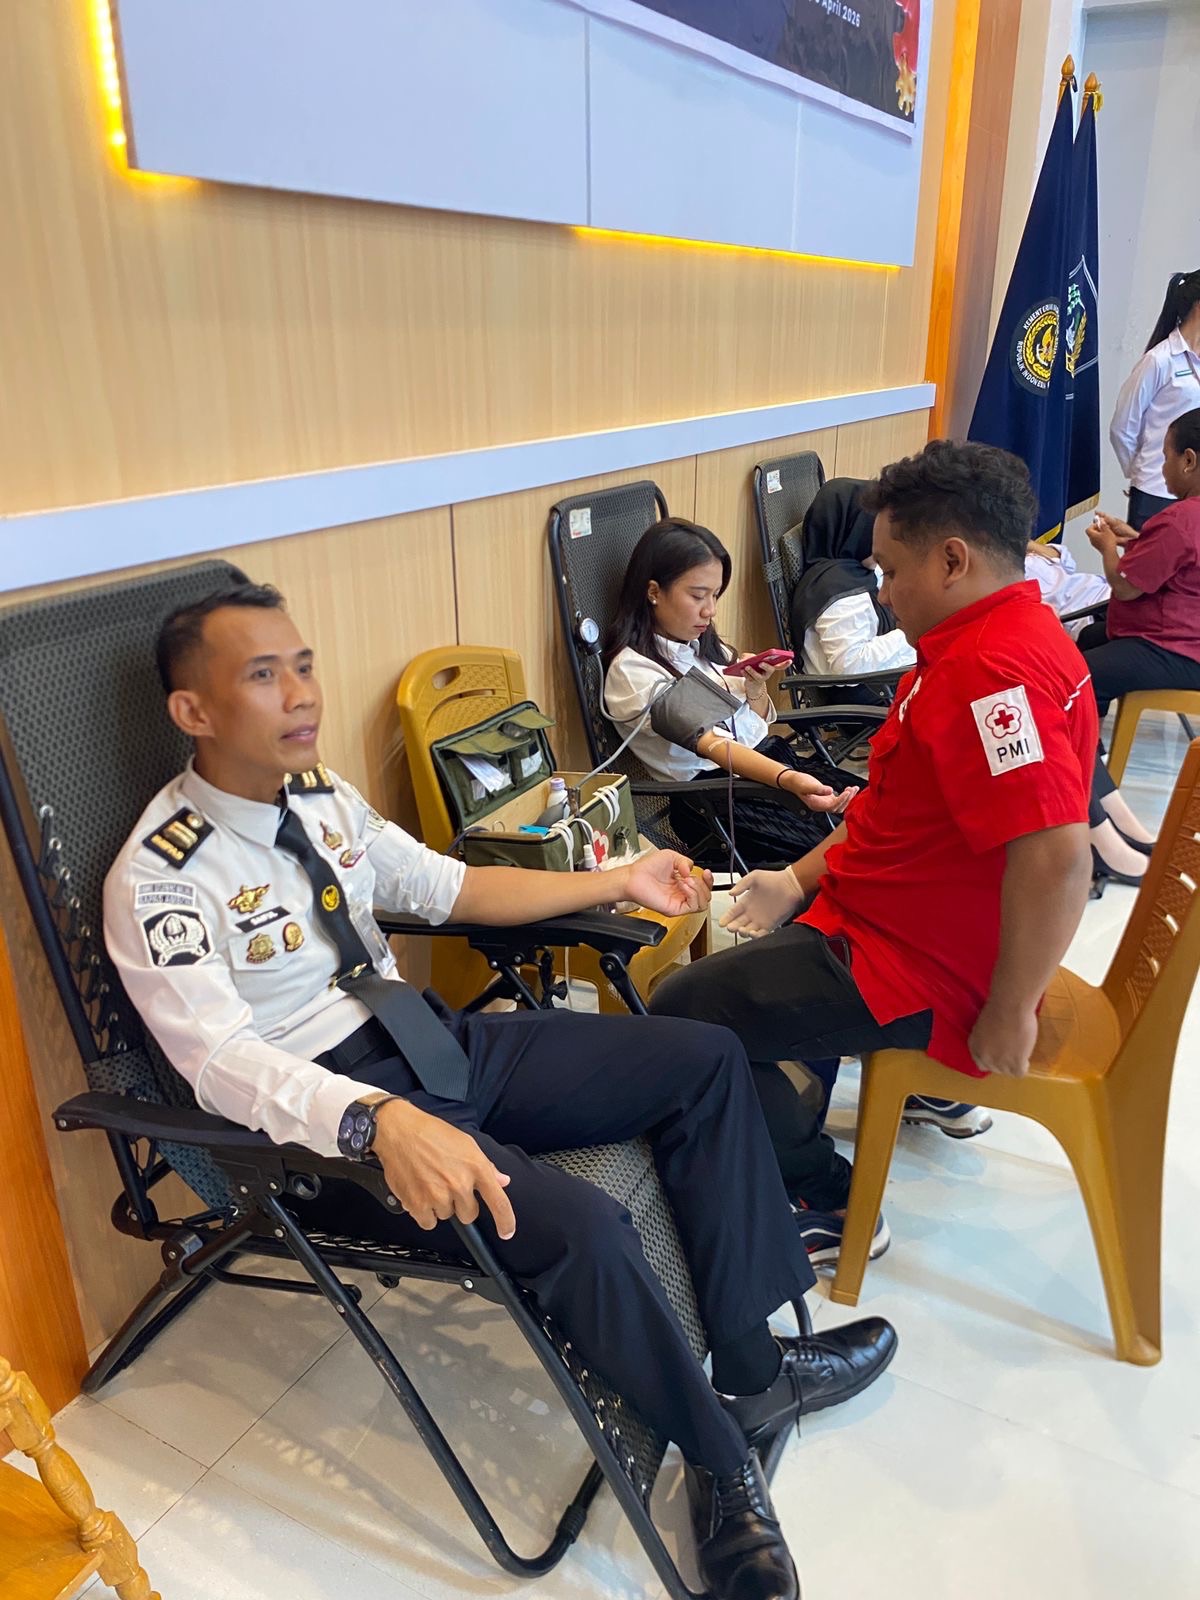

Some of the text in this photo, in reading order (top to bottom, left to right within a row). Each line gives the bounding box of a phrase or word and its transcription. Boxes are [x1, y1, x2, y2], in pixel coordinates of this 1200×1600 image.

[822, 0, 860, 27] April 2026
[996, 738, 1030, 763] PMI
